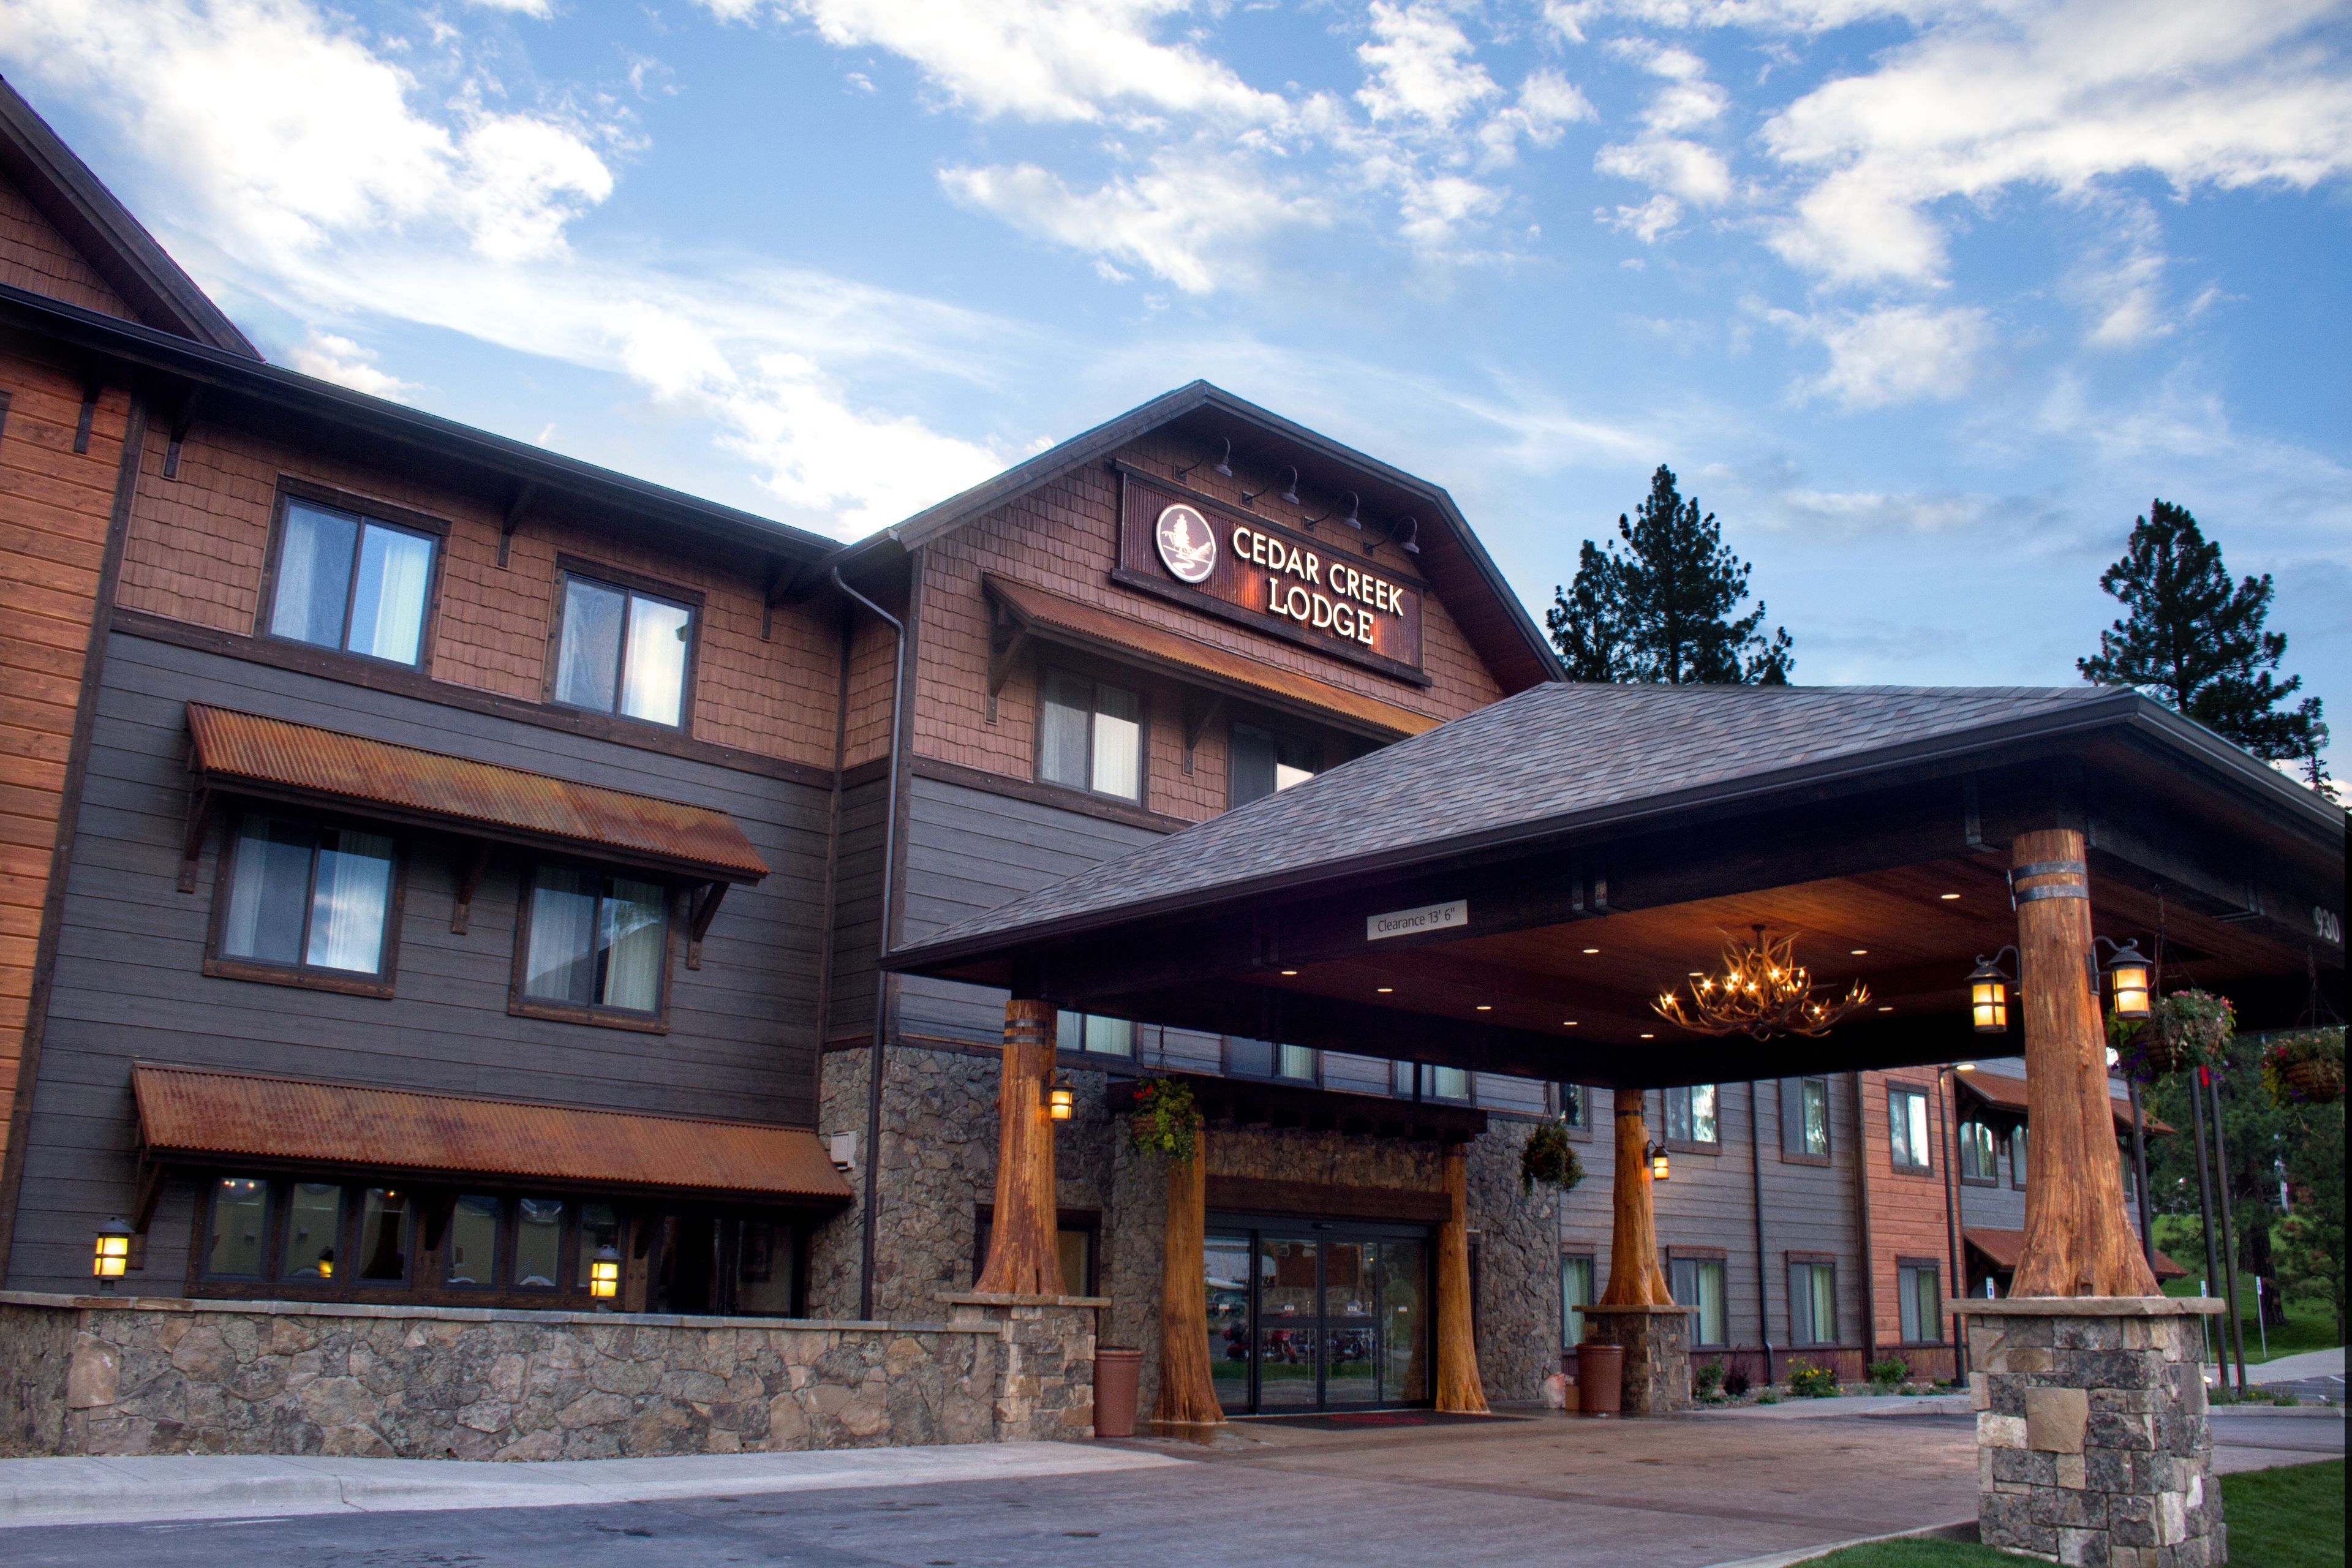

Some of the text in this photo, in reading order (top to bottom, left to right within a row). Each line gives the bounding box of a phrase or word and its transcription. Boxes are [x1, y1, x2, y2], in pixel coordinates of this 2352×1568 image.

[1233, 527, 1404, 616] CEDAR CREEK
[1269, 578, 1374, 645] LODGE
[1378, 915, 1425, 932] Clearance
[2314, 906, 2340, 943] 930
